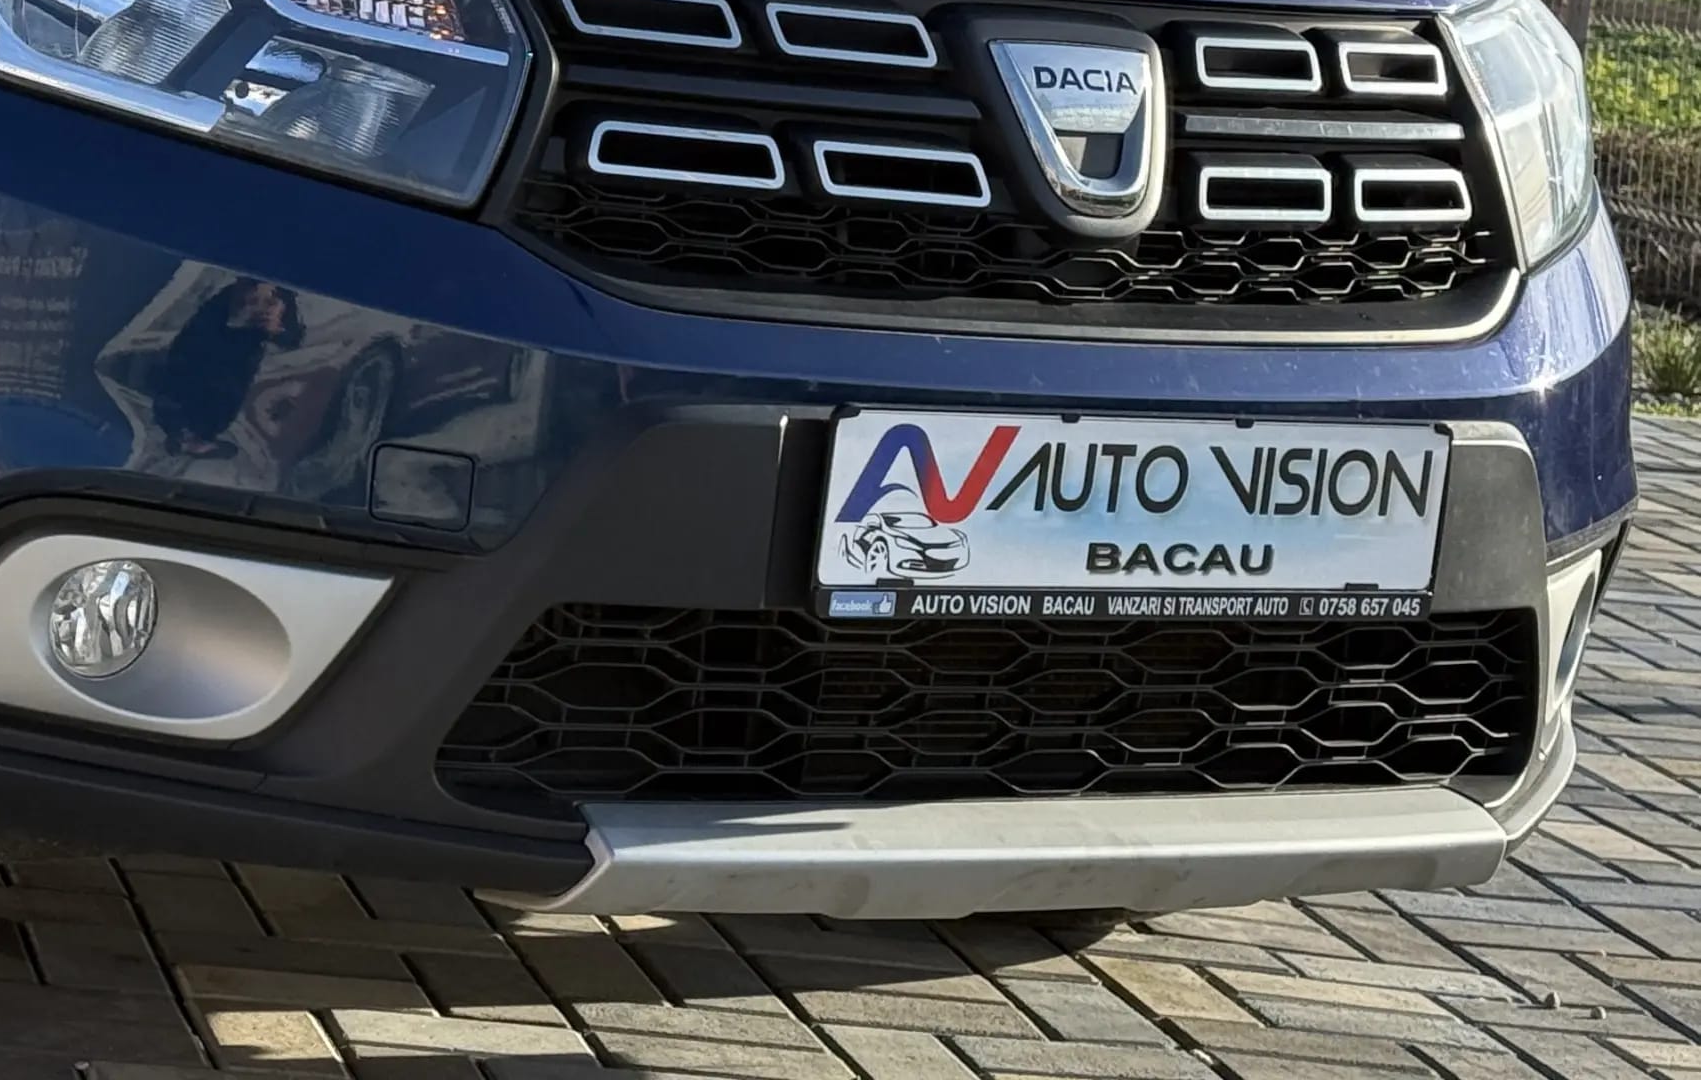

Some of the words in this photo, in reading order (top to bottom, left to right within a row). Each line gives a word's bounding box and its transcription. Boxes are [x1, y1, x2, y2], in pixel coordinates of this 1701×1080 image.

[1033, 65, 1139, 95] DACIA
[985, 441, 1189, 514] AUTO
[1210, 445, 1434, 518] VISION
[1086, 542, 1275, 576] BACAU
[831, 597, 873, 613] facebook
[911, 594, 964, 615] AUTO
[970, 594, 1032, 615] VISION
[1042, 595, 1095, 616] BACAU
[1107, 595, 1161, 616] VANZARI
[1163, 596, 1177, 616] SI
[1179, 596, 1254, 617] TRANSPORT
[1253, 597, 1289, 617] AUTO
[1319, 597, 1357, 617] 0758
[1360, 597, 1389, 617] 657
[1392, 597, 1421, 618] 045
